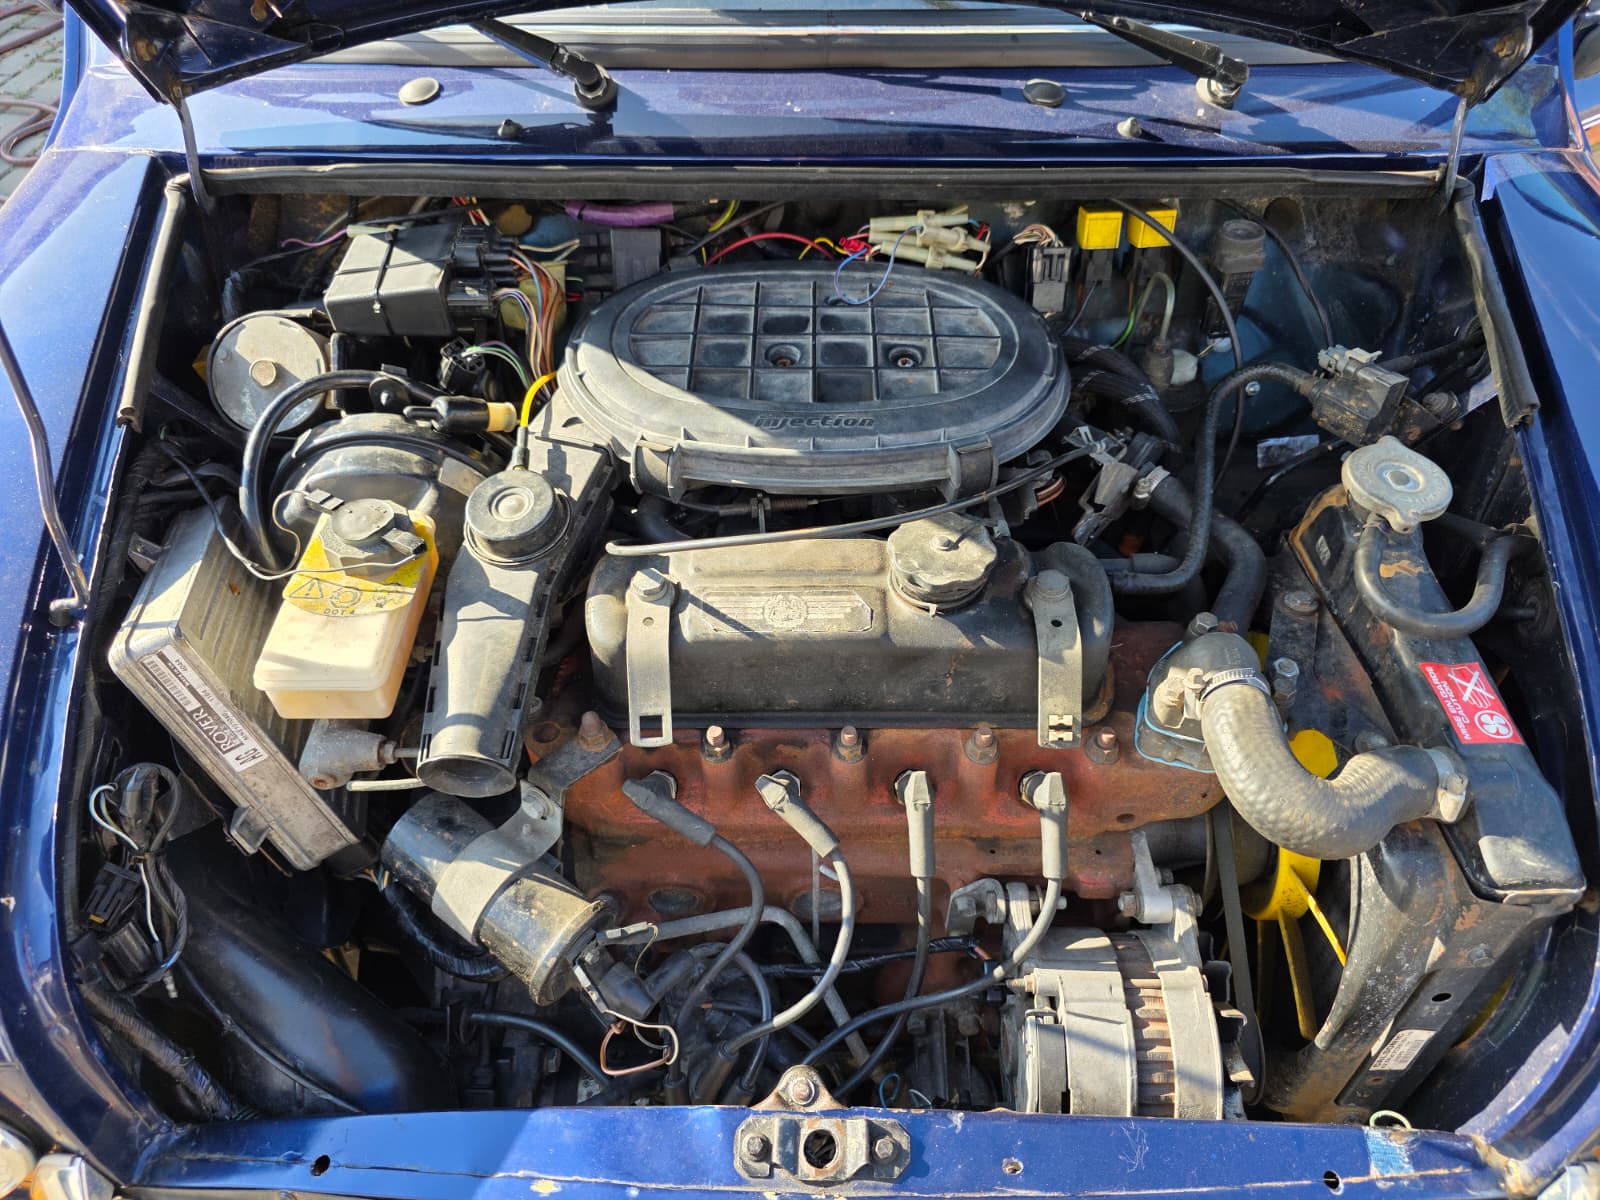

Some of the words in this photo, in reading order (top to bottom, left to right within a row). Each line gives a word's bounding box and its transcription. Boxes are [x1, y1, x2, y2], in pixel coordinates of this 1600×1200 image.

[755, 415, 875, 431] injection
[1425, 666, 1448, 698] GARDE
[1441, 680, 1470, 724] CAUTION
[1445, 700, 1457, 714] EN
[192, 708, 235, 752] ROVER
[1454, 715, 1472, 740] MISE
